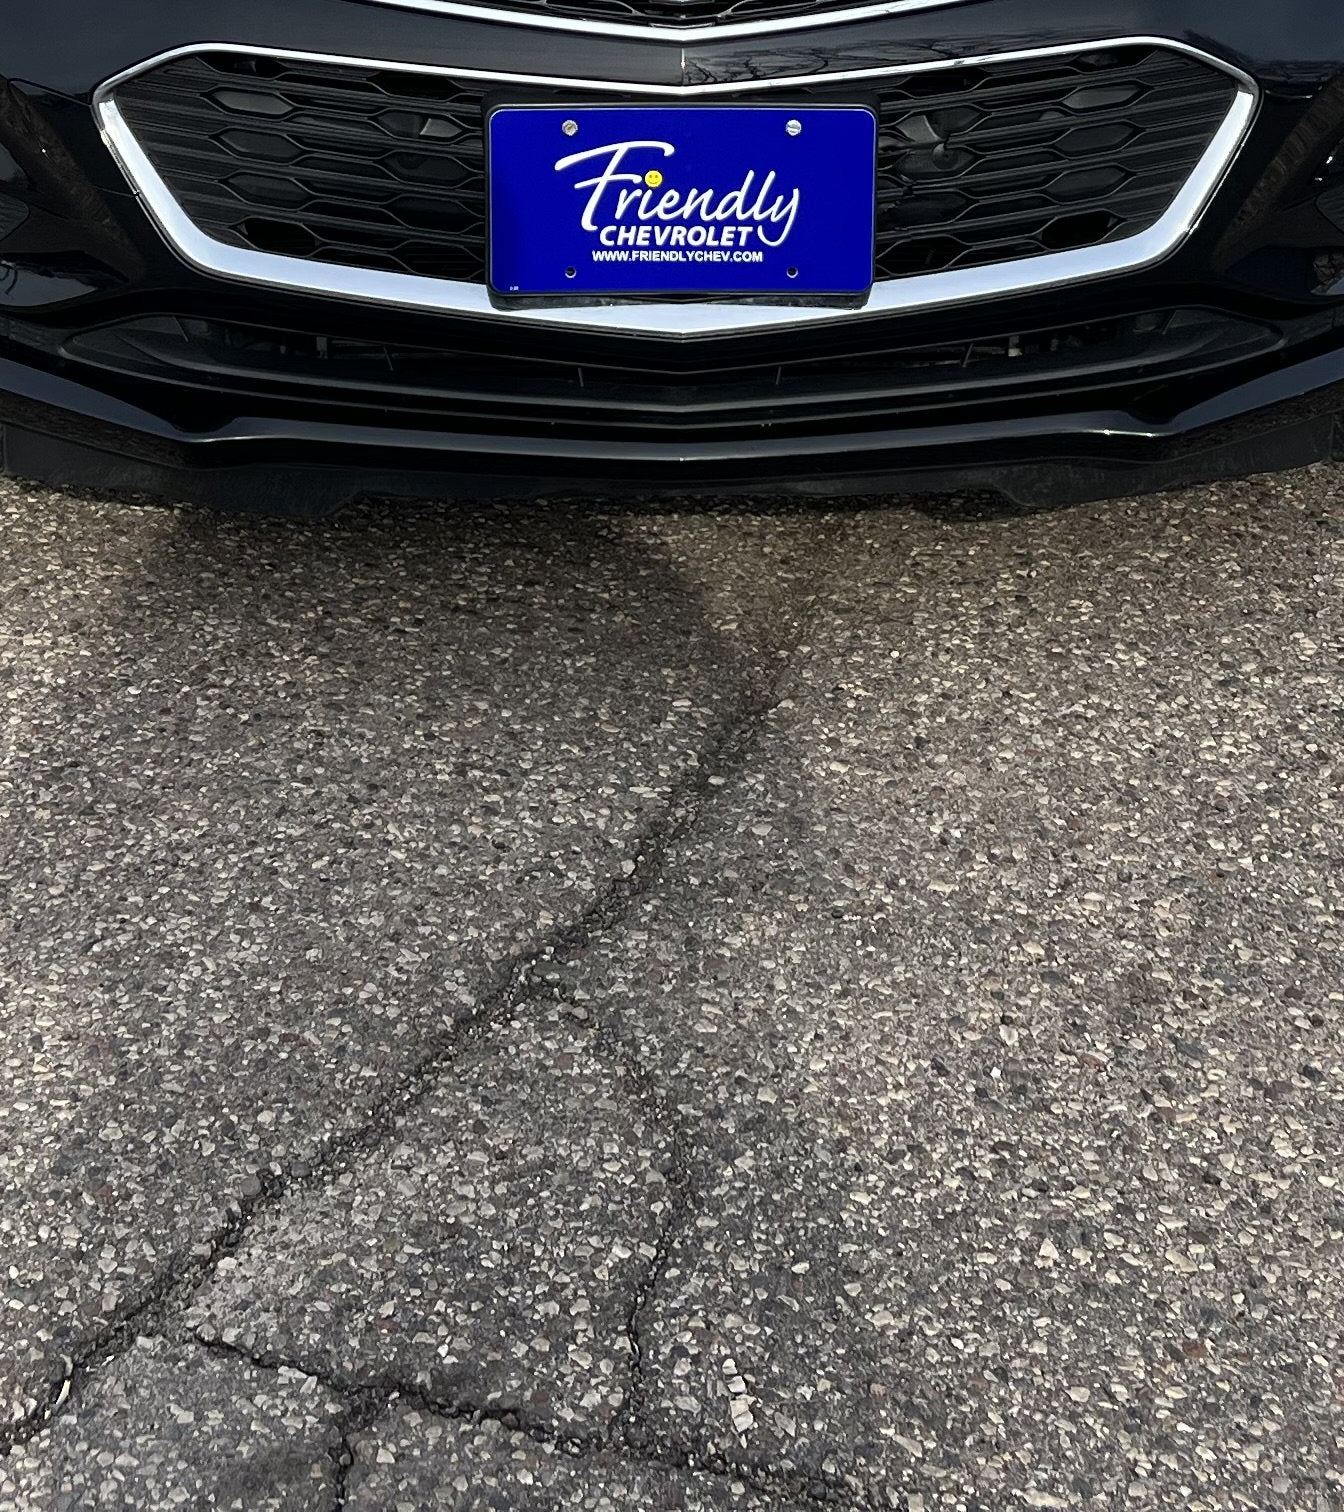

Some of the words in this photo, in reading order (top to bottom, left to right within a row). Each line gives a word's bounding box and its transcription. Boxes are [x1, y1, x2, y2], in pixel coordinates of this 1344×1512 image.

[554, 140, 800, 247] Friendly
[599, 225, 753, 247] CHEVROLET
[592, 250, 763, 263] WWW.FRIENDLYCHEV.COM
